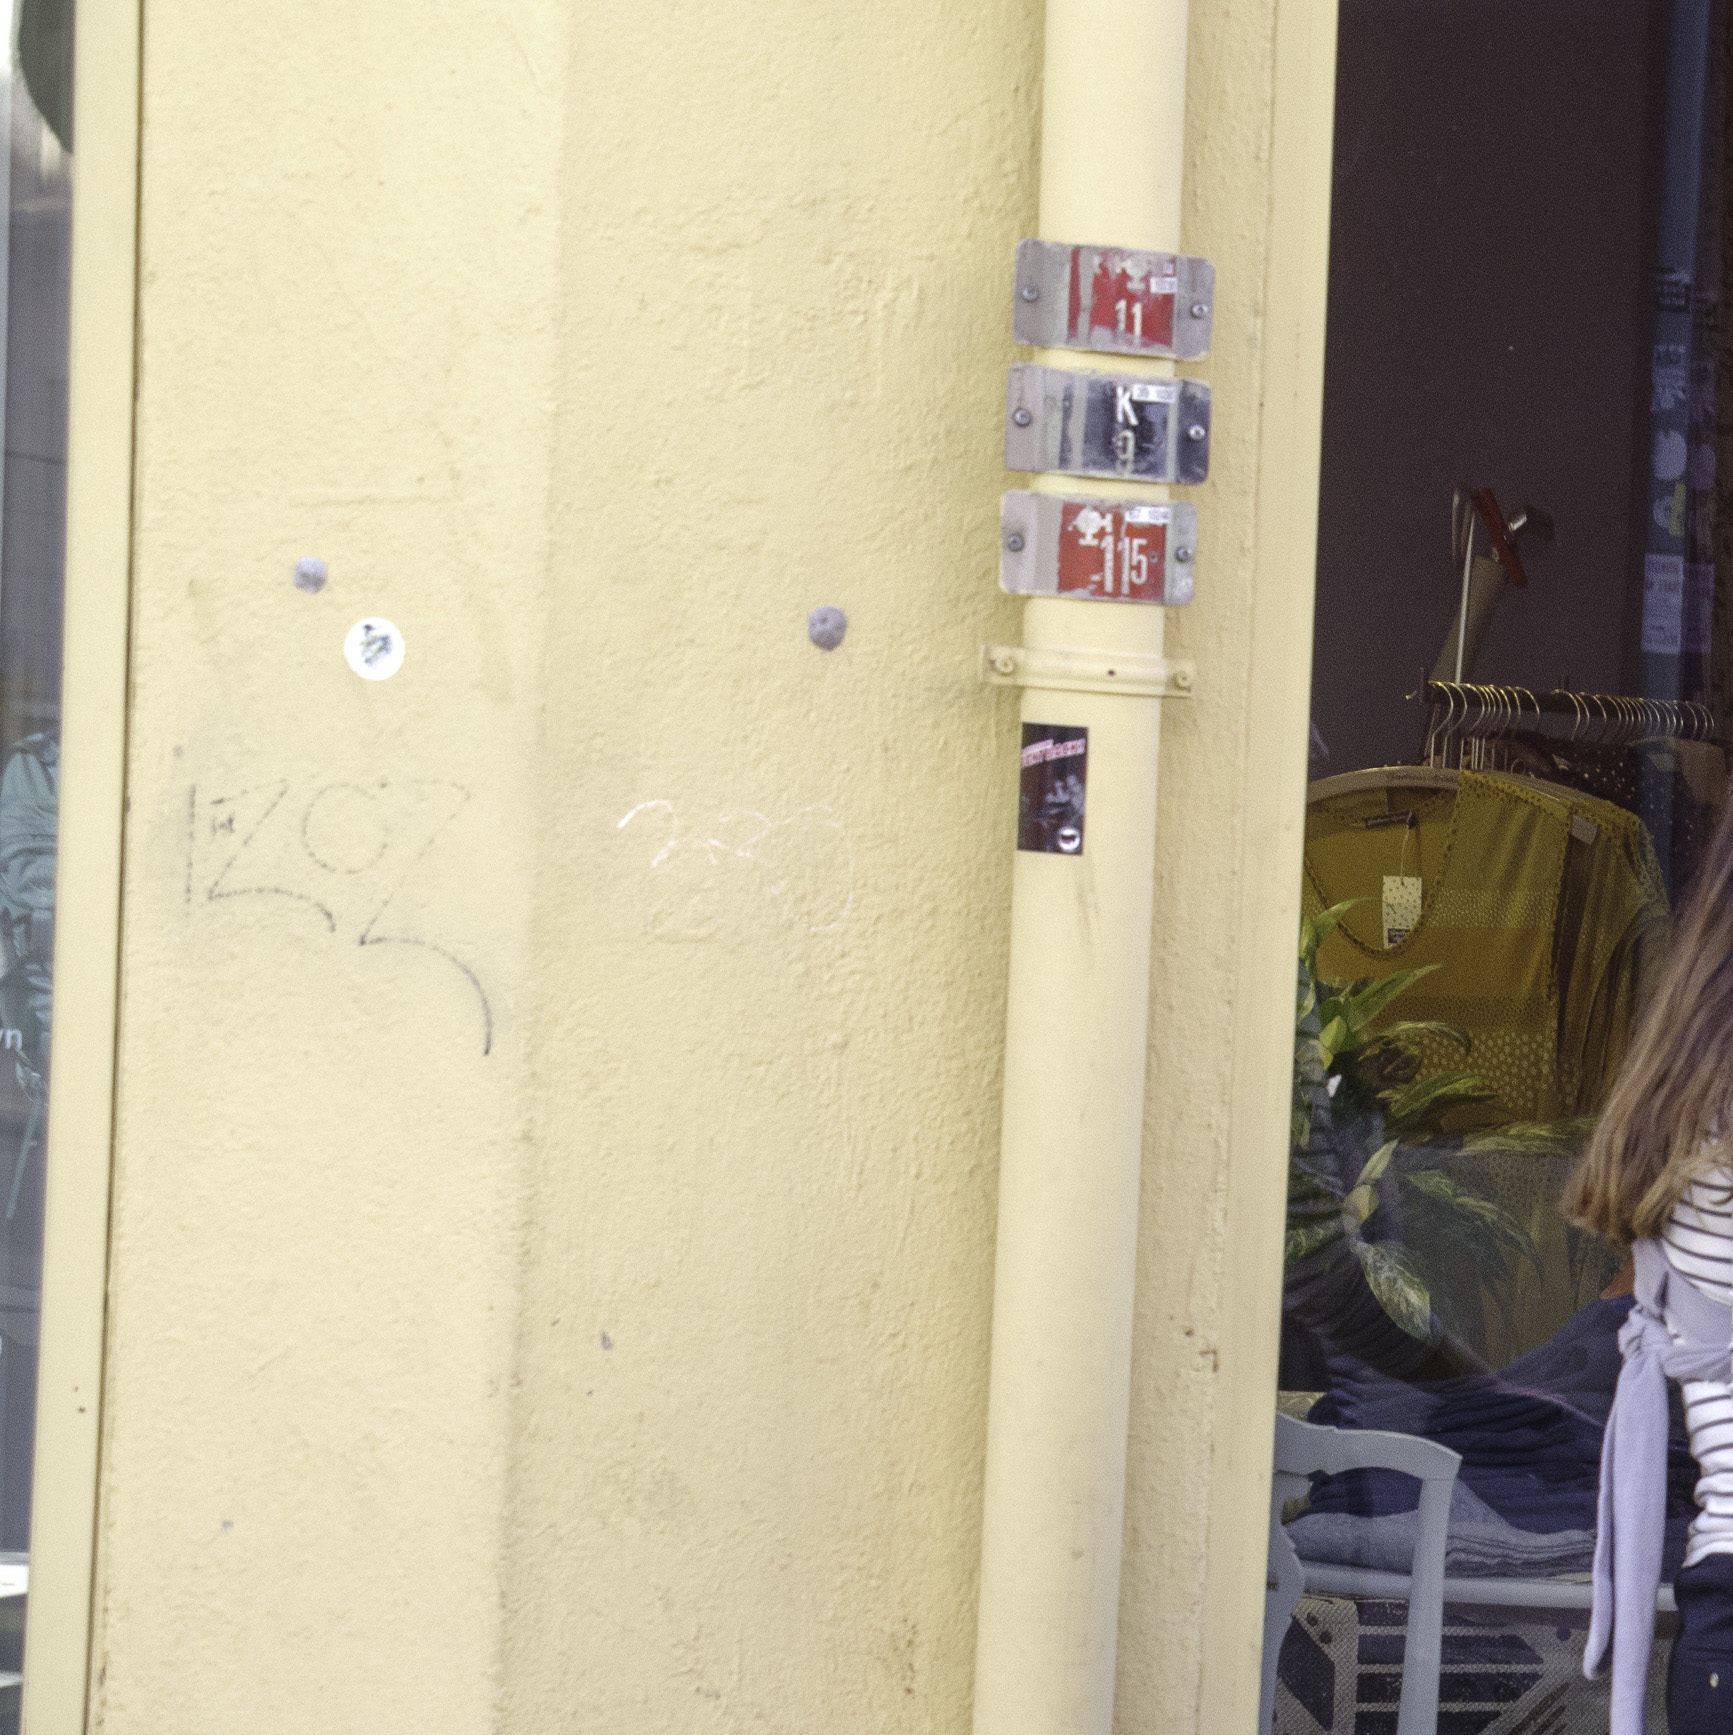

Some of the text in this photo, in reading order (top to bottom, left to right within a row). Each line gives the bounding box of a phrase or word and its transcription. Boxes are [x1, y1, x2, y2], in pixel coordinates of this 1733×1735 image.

[1115, 299, 1143, 344] 11
[1116, 386, 1139, 426] K
[1101, 534, 1149, 595] 115
